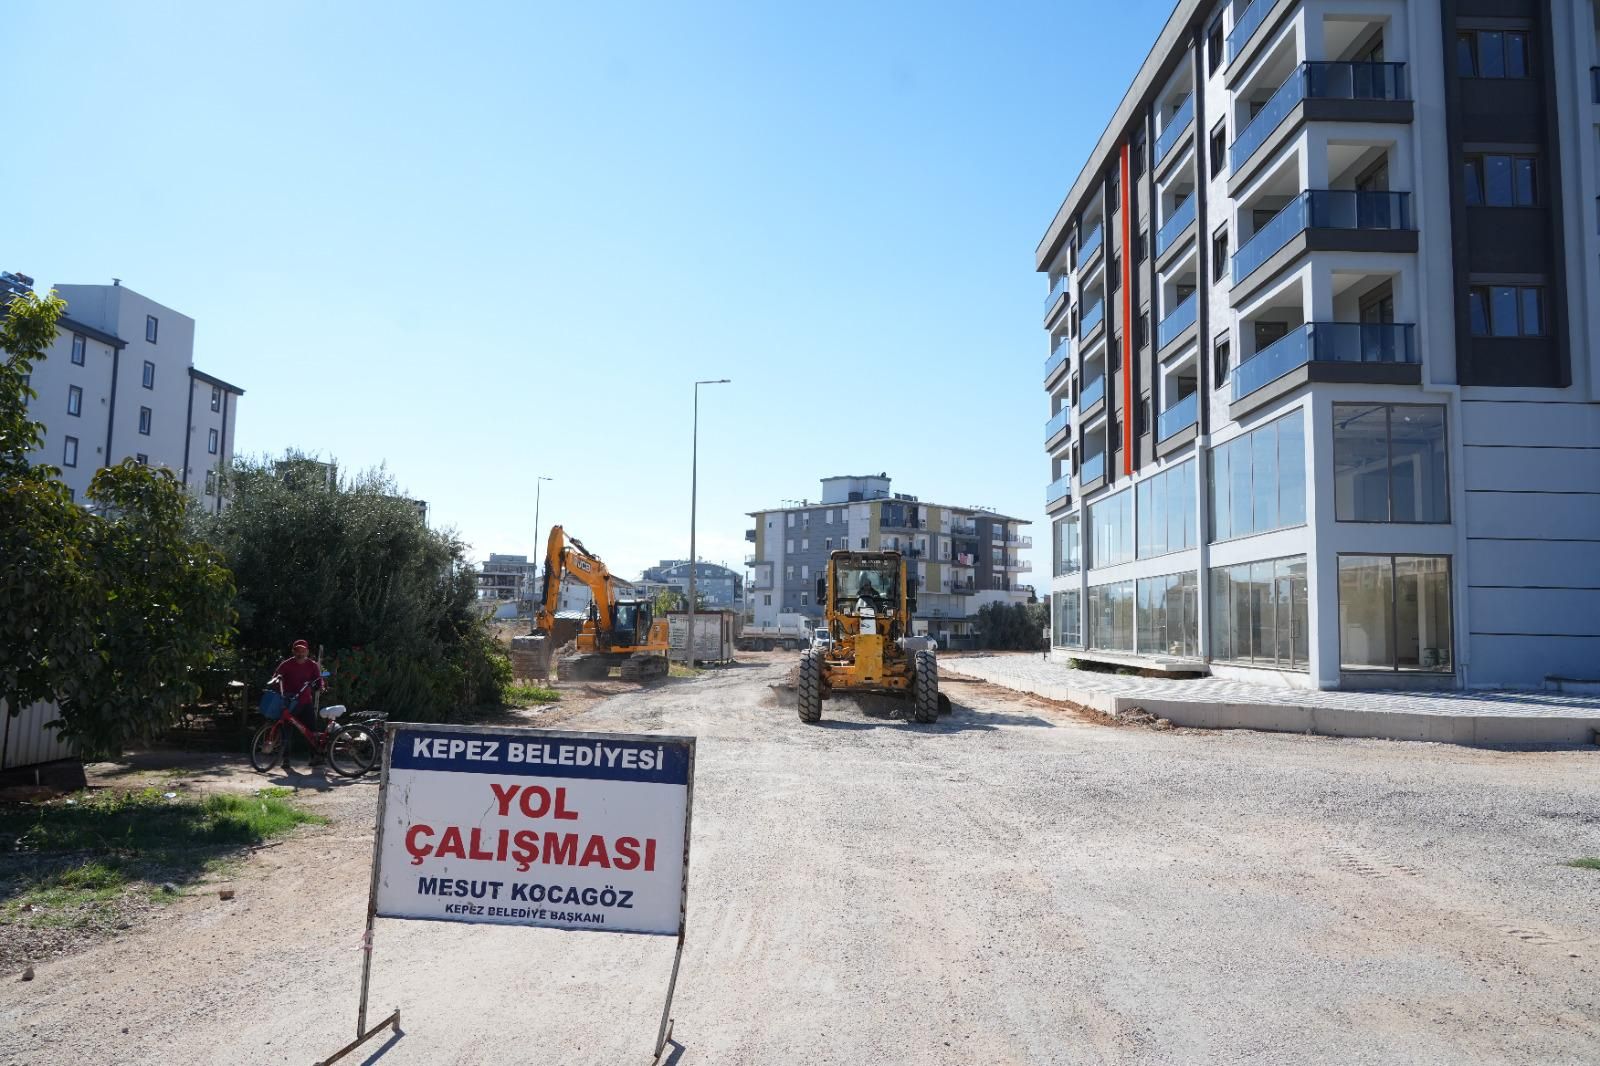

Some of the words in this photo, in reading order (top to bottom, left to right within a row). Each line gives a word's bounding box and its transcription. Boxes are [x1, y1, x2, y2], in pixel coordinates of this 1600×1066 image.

[412, 738, 500, 761] KEPEZ
[507, 742, 664, 770] BELEDİYESİ
[490, 783, 579, 820] YOL
[405, 824, 656, 872] ÇALIŞMASI
[417, 876, 504, 900] MESUT
[511, 883, 634, 908] KOCAGÖZ
[445, 903, 485, 915] KEPEZ
[487, 906, 547, 919] BELEDİYE
[550, 910, 605, 924] BAŞKANI
